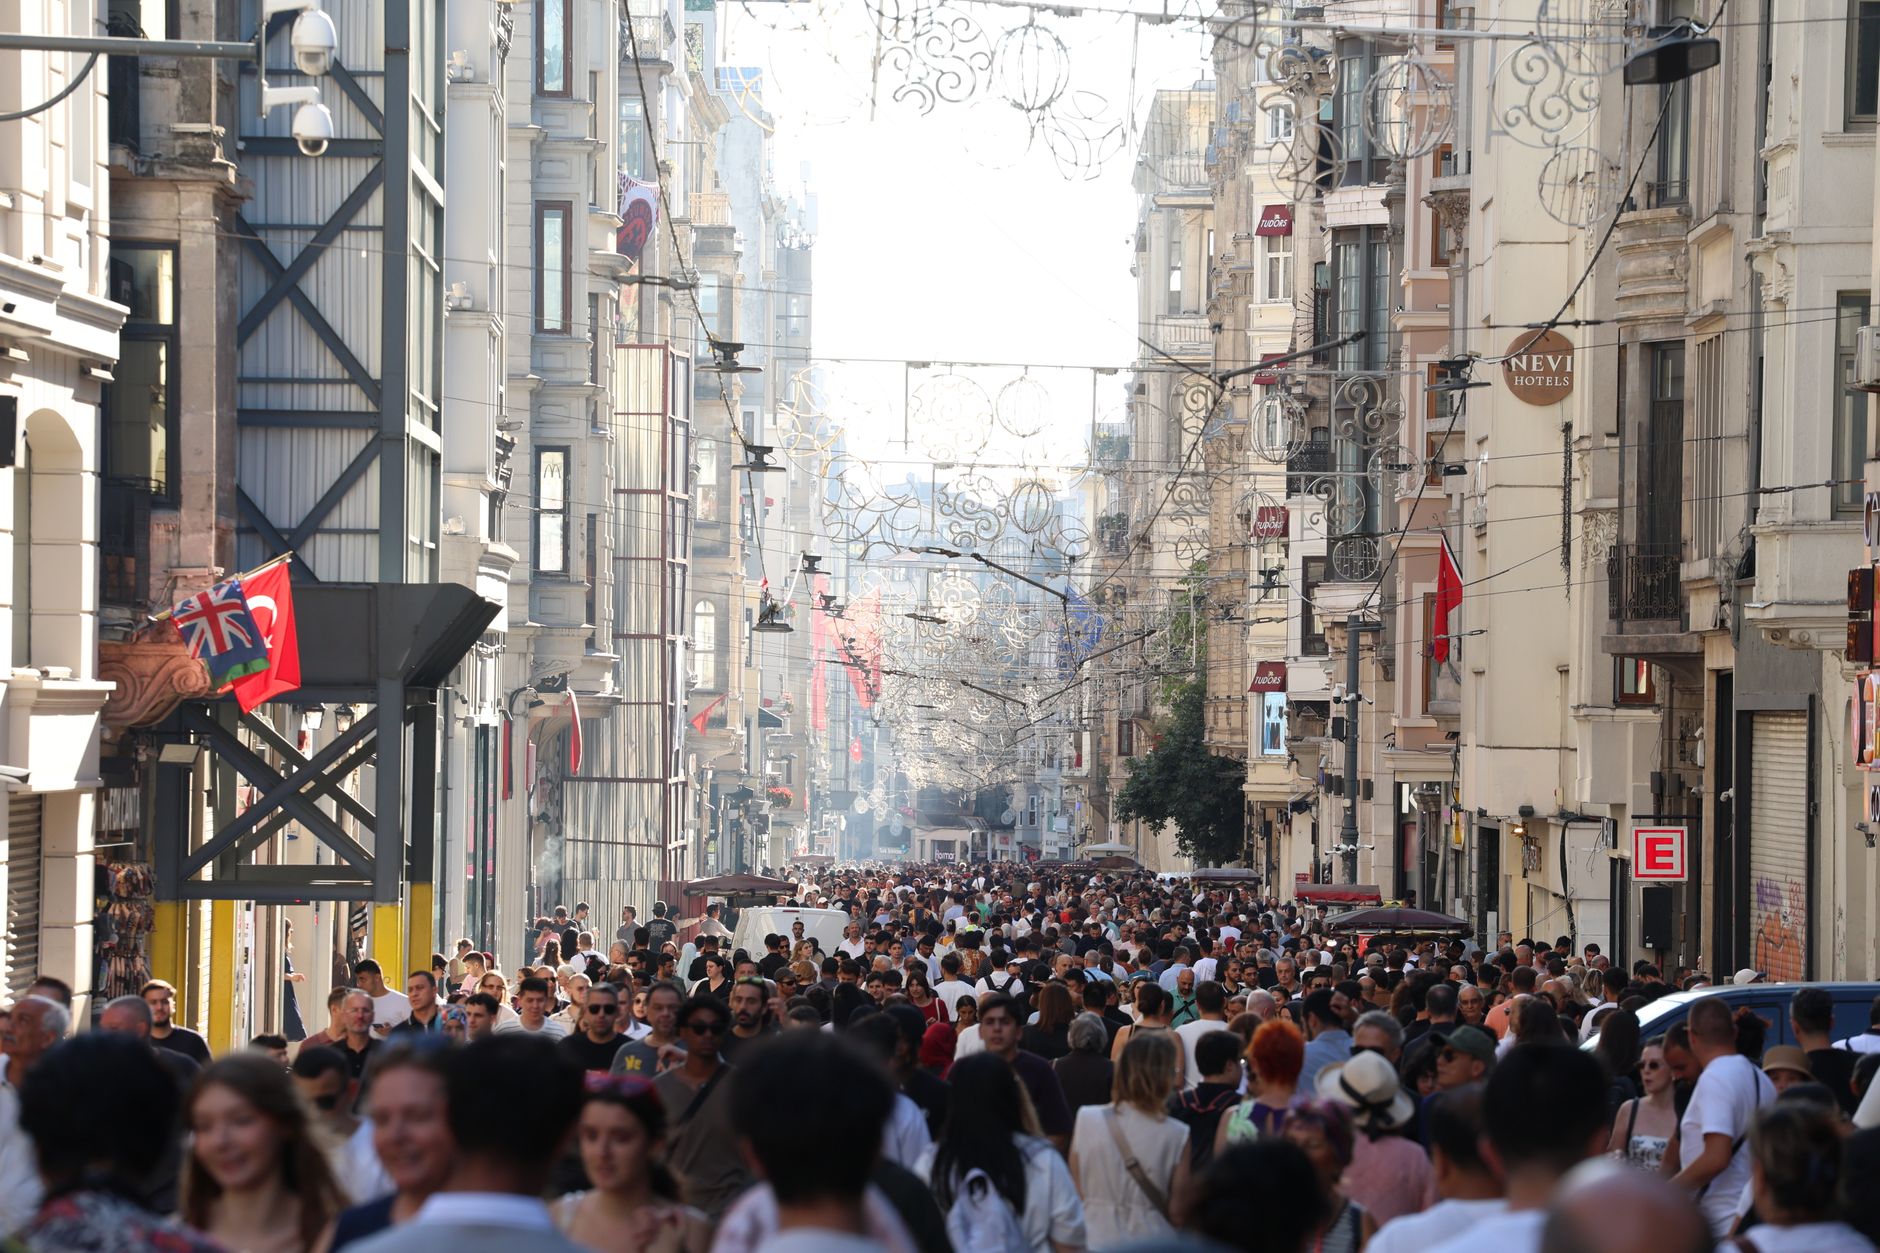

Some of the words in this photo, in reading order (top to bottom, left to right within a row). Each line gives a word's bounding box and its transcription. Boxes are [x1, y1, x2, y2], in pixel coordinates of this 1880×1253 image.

[1260, 219, 1288, 228] TUDORS
[1510, 354, 1573, 372] NEVI
[1514, 375, 1570, 387] HOTELS
[1254, 676, 1282, 685] TUDORS
[1645, 837, 1674, 870] E
